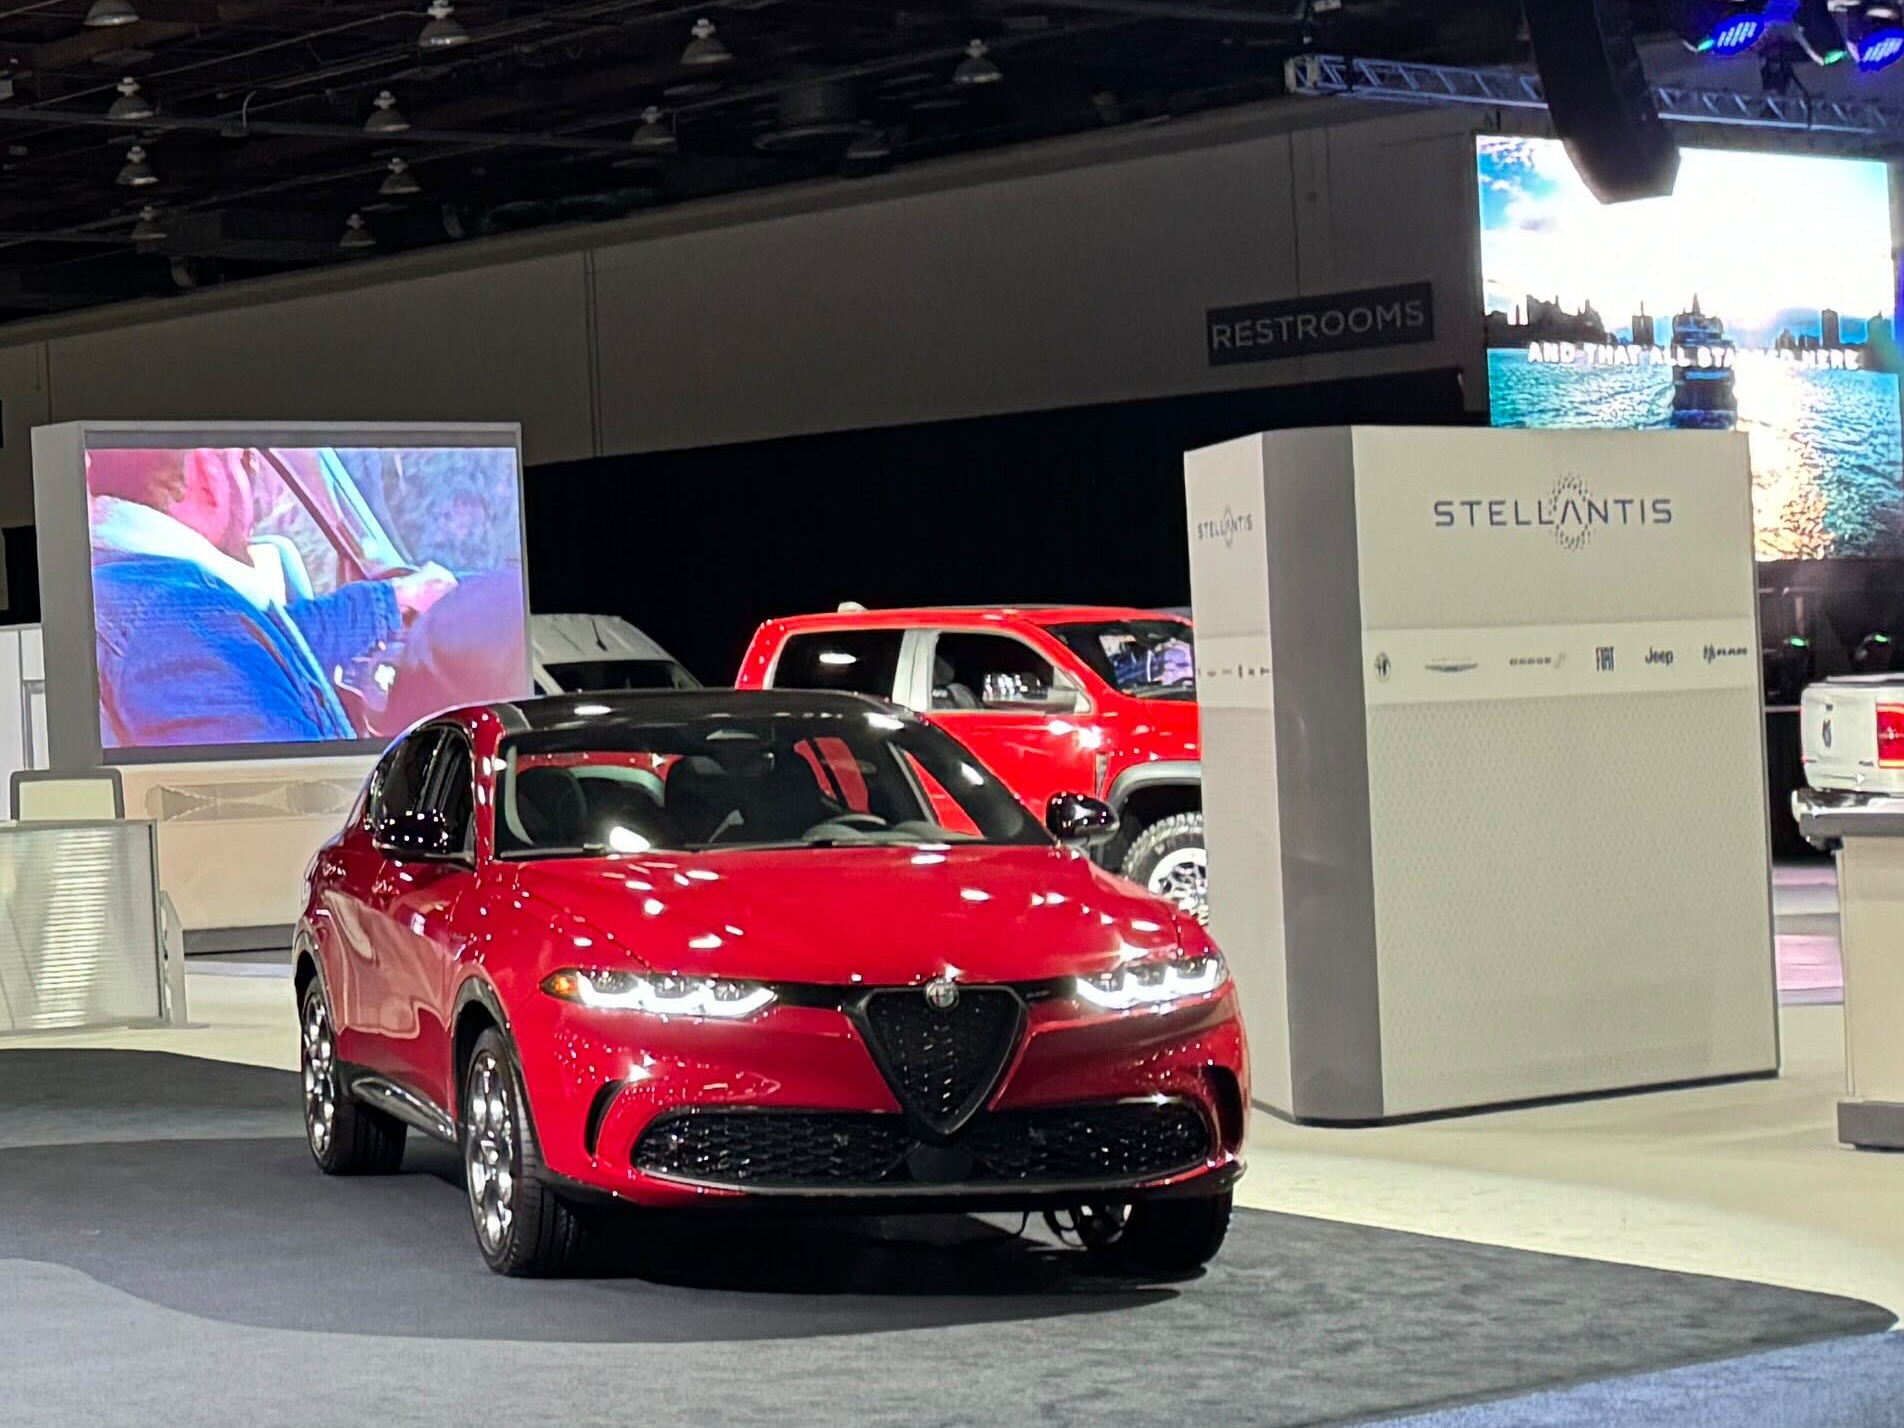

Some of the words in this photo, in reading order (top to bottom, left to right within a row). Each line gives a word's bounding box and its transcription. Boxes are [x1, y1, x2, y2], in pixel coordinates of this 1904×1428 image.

[1212, 300, 1425, 350] RESTROOMS
[1527, 341, 1577, 365] AND
[1583, 343, 1642, 366] THAT
[1649, 345, 1691, 368] ALL
[1433, 498, 1673, 527] STELLANTIS
[1197, 513, 1253, 540] STELLANTIS
[1596, 646, 1615, 672] FIAT
[1645, 646, 1674, 666] Jeep
